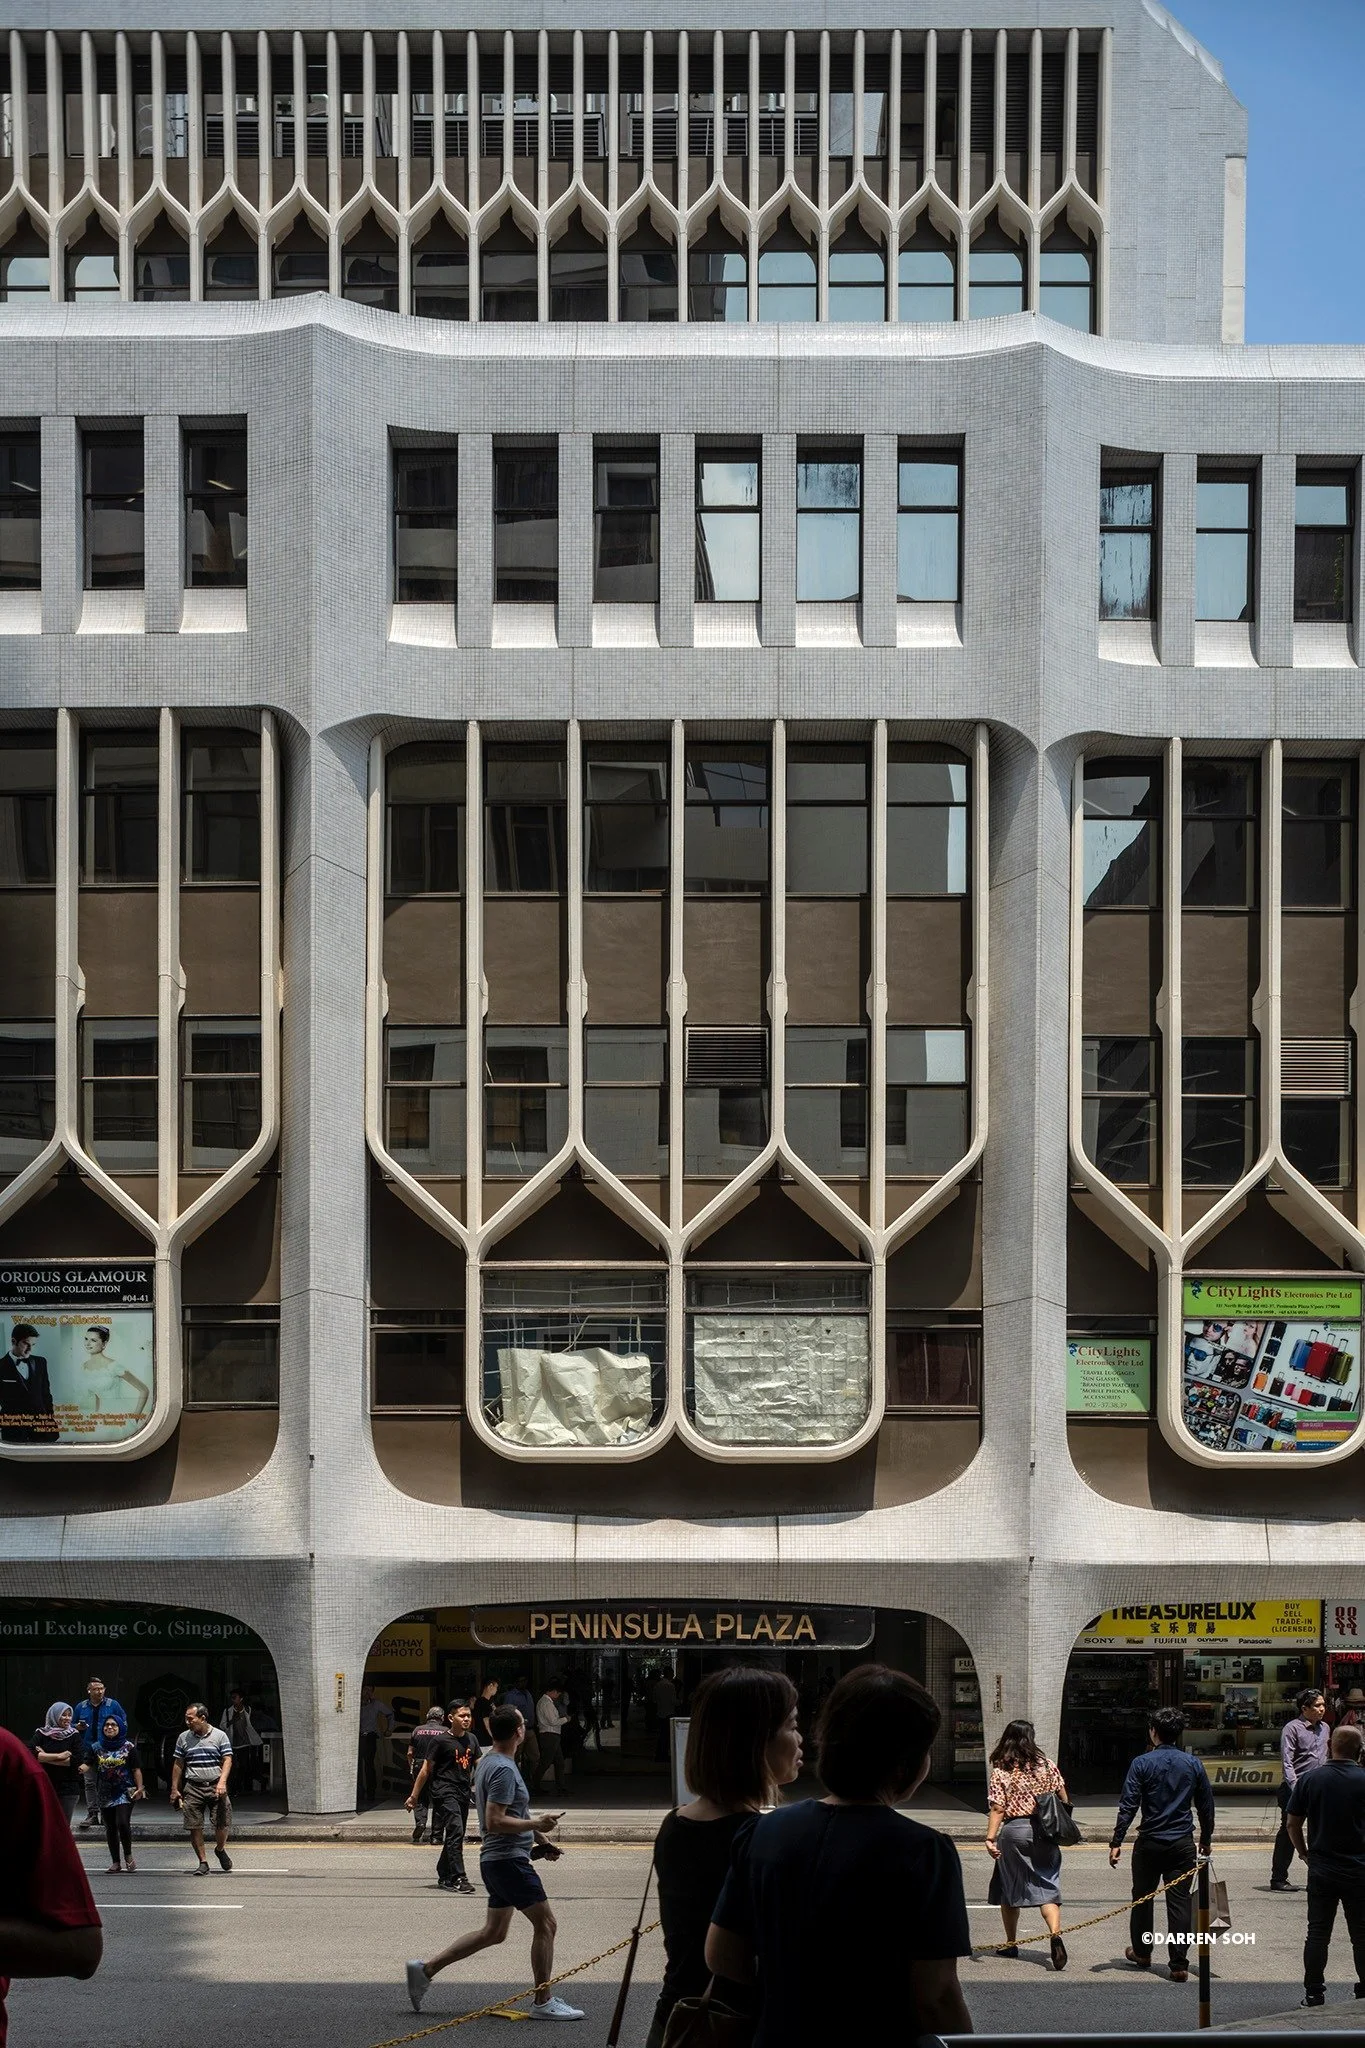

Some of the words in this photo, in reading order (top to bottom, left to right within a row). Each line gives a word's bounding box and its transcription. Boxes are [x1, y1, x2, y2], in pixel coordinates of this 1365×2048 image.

[0, 1271, 61, 1283] ORIOUS
[65, 1270, 148, 1283] GLAMOUR
[16, 1285, 61, 1293] WEDDING
[62, 1285, 121, 1293] COLLECTION
[1206, 1285, 1282, 1301] CityLights
[122, 1294, 149, 1302] #04-41
[11, 1315, 57, 1326] Wedding
[59, 1315, 112, 1325] Collection
[1078, 1346, 1141, 1359] CityLights
[0, 1620, 39, 1635] ional
[45, 1620, 128, 1639] Exchange
[132, 1620, 162, 1635] Co.
[478, 1624, 505, 1633] Union
[508, 1624, 526, 1633] WU
[529, 1613, 704, 1640] PENINSULA
[715, 1613, 817, 1641] PLAZA
[1150, 1622, 1216, 1634] 宝乐贸易
[1272, 1625, 1316, 1633] (LICENSED)
[382, 1639, 424, 1648] CATHAY
[382, 1648, 424, 1657] PHOTO
[1215, 1767, 1274, 1783] Nikon
